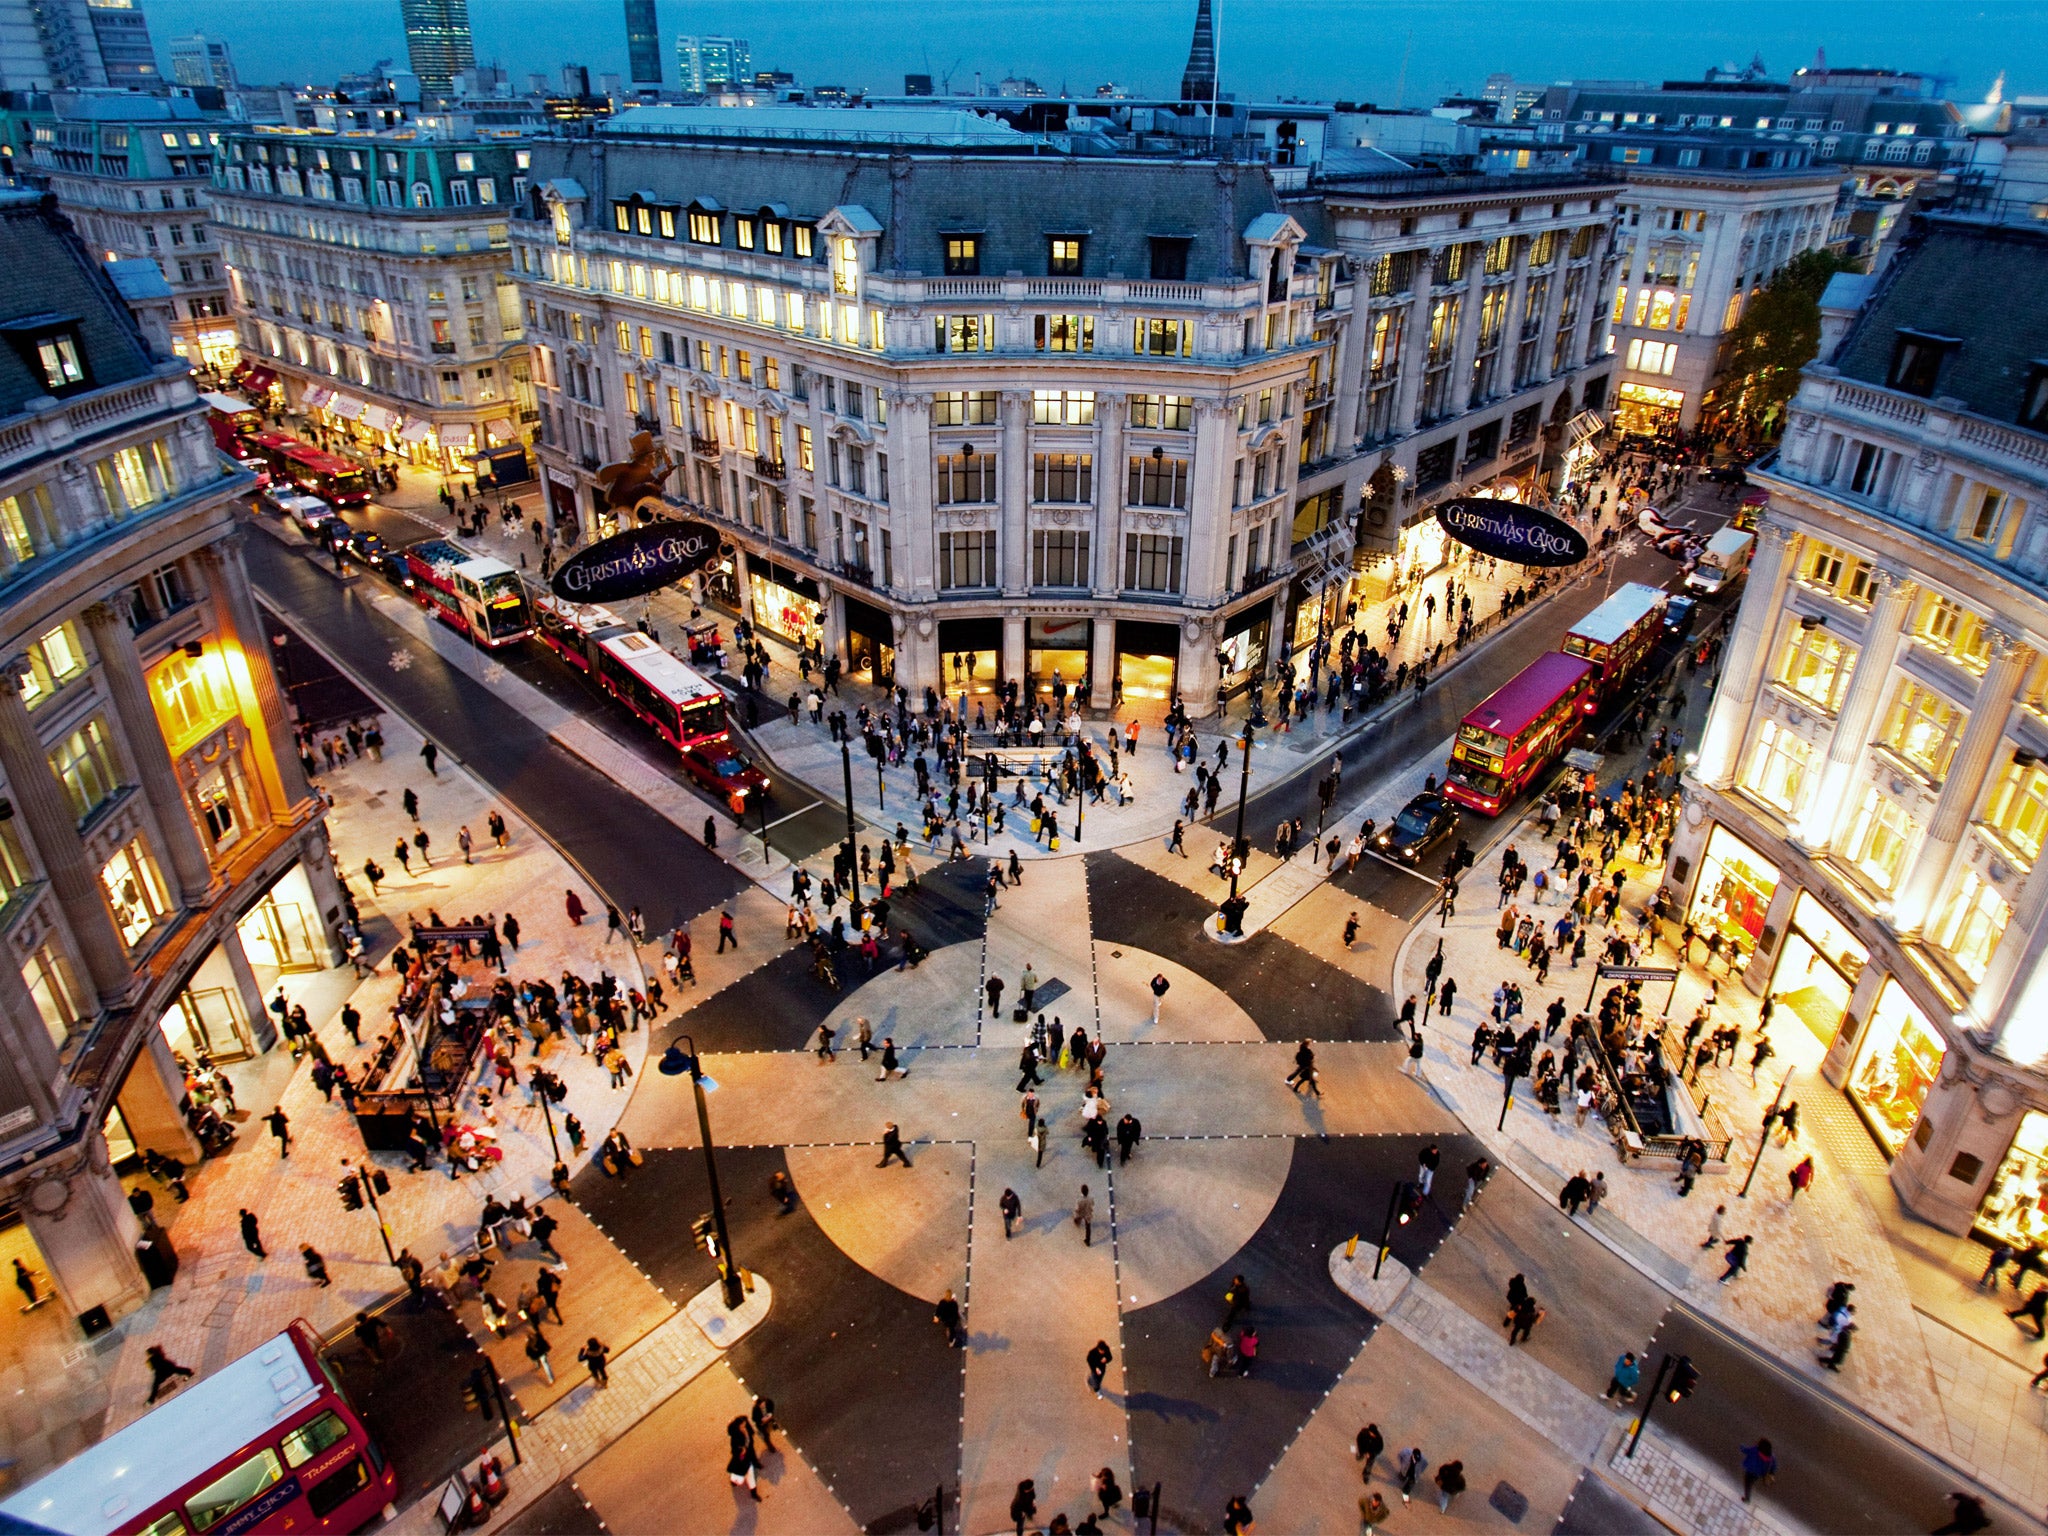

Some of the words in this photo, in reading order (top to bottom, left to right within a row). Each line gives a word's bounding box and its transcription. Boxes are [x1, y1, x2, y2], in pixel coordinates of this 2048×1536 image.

[1446, 505, 1525, 544] CHRISTMAS
[1526, 525, 1575, 555] CAROL
[1505, 514, 1514, 523] A
[562, 548, 657, 592] CHRISTMAS
[657, 535, 710, 564] CAROL
[258, 1484, 295, 1512] CHOO
